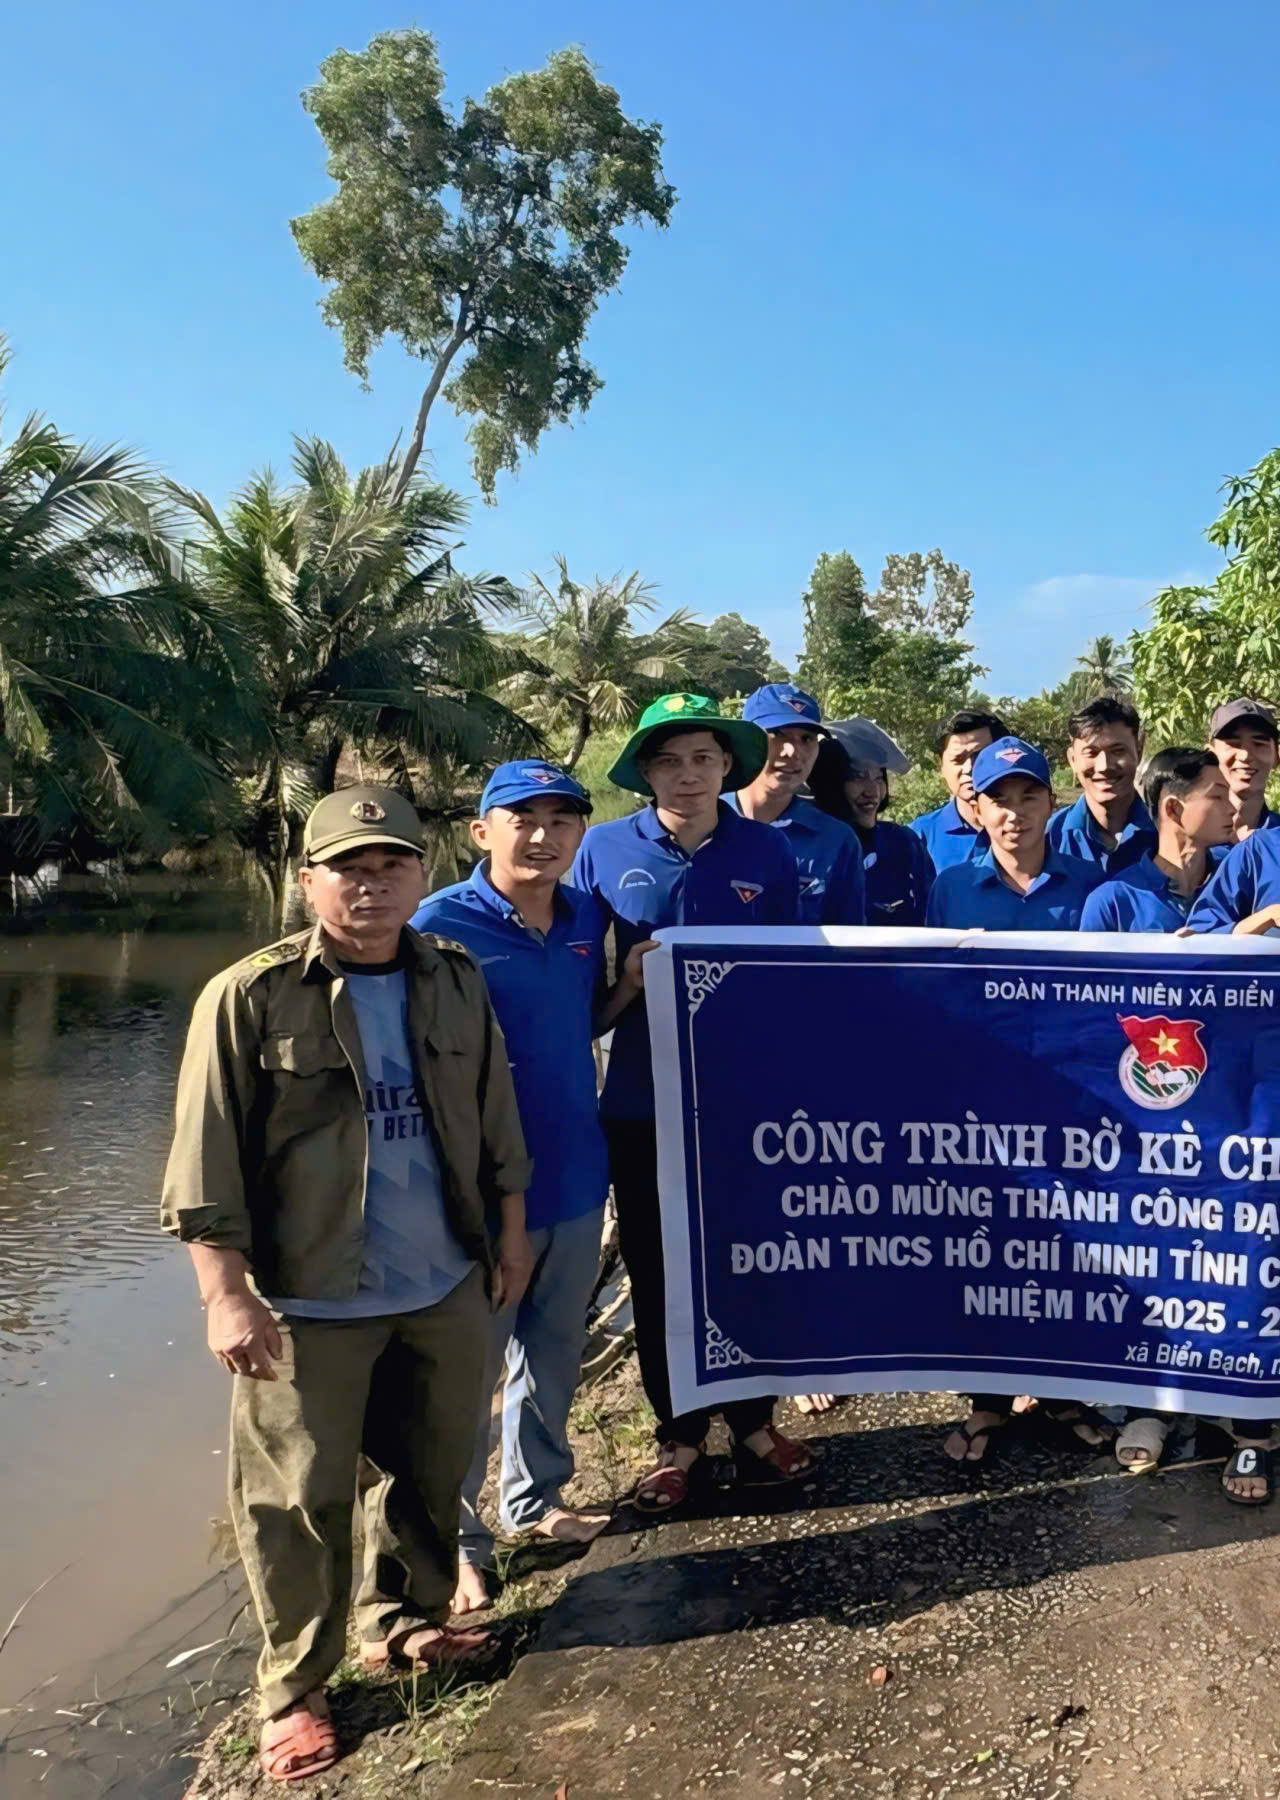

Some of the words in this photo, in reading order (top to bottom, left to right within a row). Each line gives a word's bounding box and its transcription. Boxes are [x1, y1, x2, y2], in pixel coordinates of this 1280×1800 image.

[985, 978, 1045, 1000] ĐOÀN
[1052, 984, 1124, 1003] THANH
[1132, 982, 1182, 1006] NIÊN
[1189, 988, 1216, 1006] XÃ
[1225, 980, 1273, 1007] BIỂN
[753, 1109, 885, 1165] CÔNG
[900, 1111, 1047, 1167] TRÌNH
[1062, 1117, 1122, 1172] BỜ
[1138, 1120, 1202, 1176] KÈ
[782, 1176, 879, 1217] CHÀO
[893, 1177, 992, 1217] MỪNG
[1003, 1181, 1119, 1223] THÀNH
[1131, 1187, 1223, 1231] CÔNG
[731, 1231, 830, 1273] ĐOÀN
[841, 1236, 932, 1266] TNCS
[945, 1225, 991, 1268] HỒ
[1004, 1234, 1061, 1271] CHÍ
[1074, 1242, 1158, 1277] MINH
[1170, 1239, 1248, 1286] TỈNH
[965, 1280, 1072, 1323] NHIỆM
[1086, 1285, 1129, 1323] KỲ
[1143, 1296, 1226, 1334] 2025
[1125, 1342, 1148, 1362] xã
[1156, 1341, 1202, 1367] Biển
[1207, 1349, 1264, 1378] Bạch,
